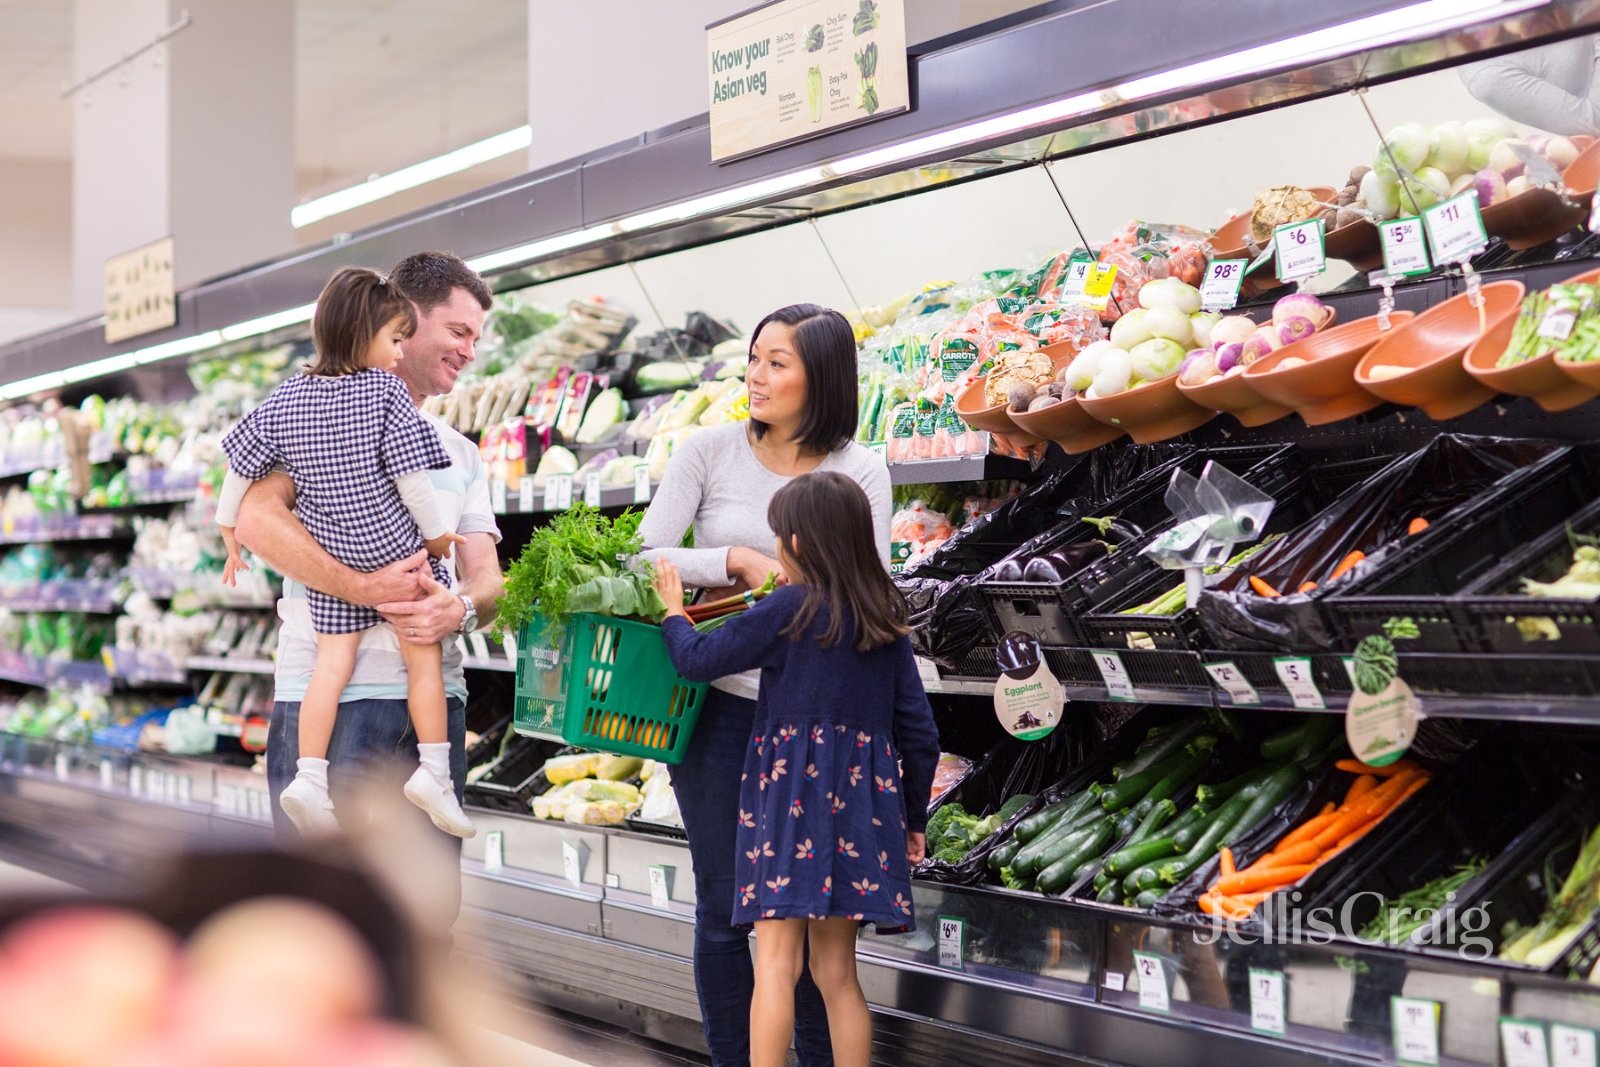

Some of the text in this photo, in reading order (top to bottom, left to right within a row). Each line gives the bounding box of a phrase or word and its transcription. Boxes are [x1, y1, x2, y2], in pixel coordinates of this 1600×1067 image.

[712, 47, 743, 74] Know
[745, 38, 770, 70] your
[713, 70, 767, 104] Asian veg
[1440, 204, 1459, 222] $11
[1290, 228, 1307, 245] $6
[942, 352, 977, 361] CARROTS
[1004, 681, 1043, 697] Eggplant
